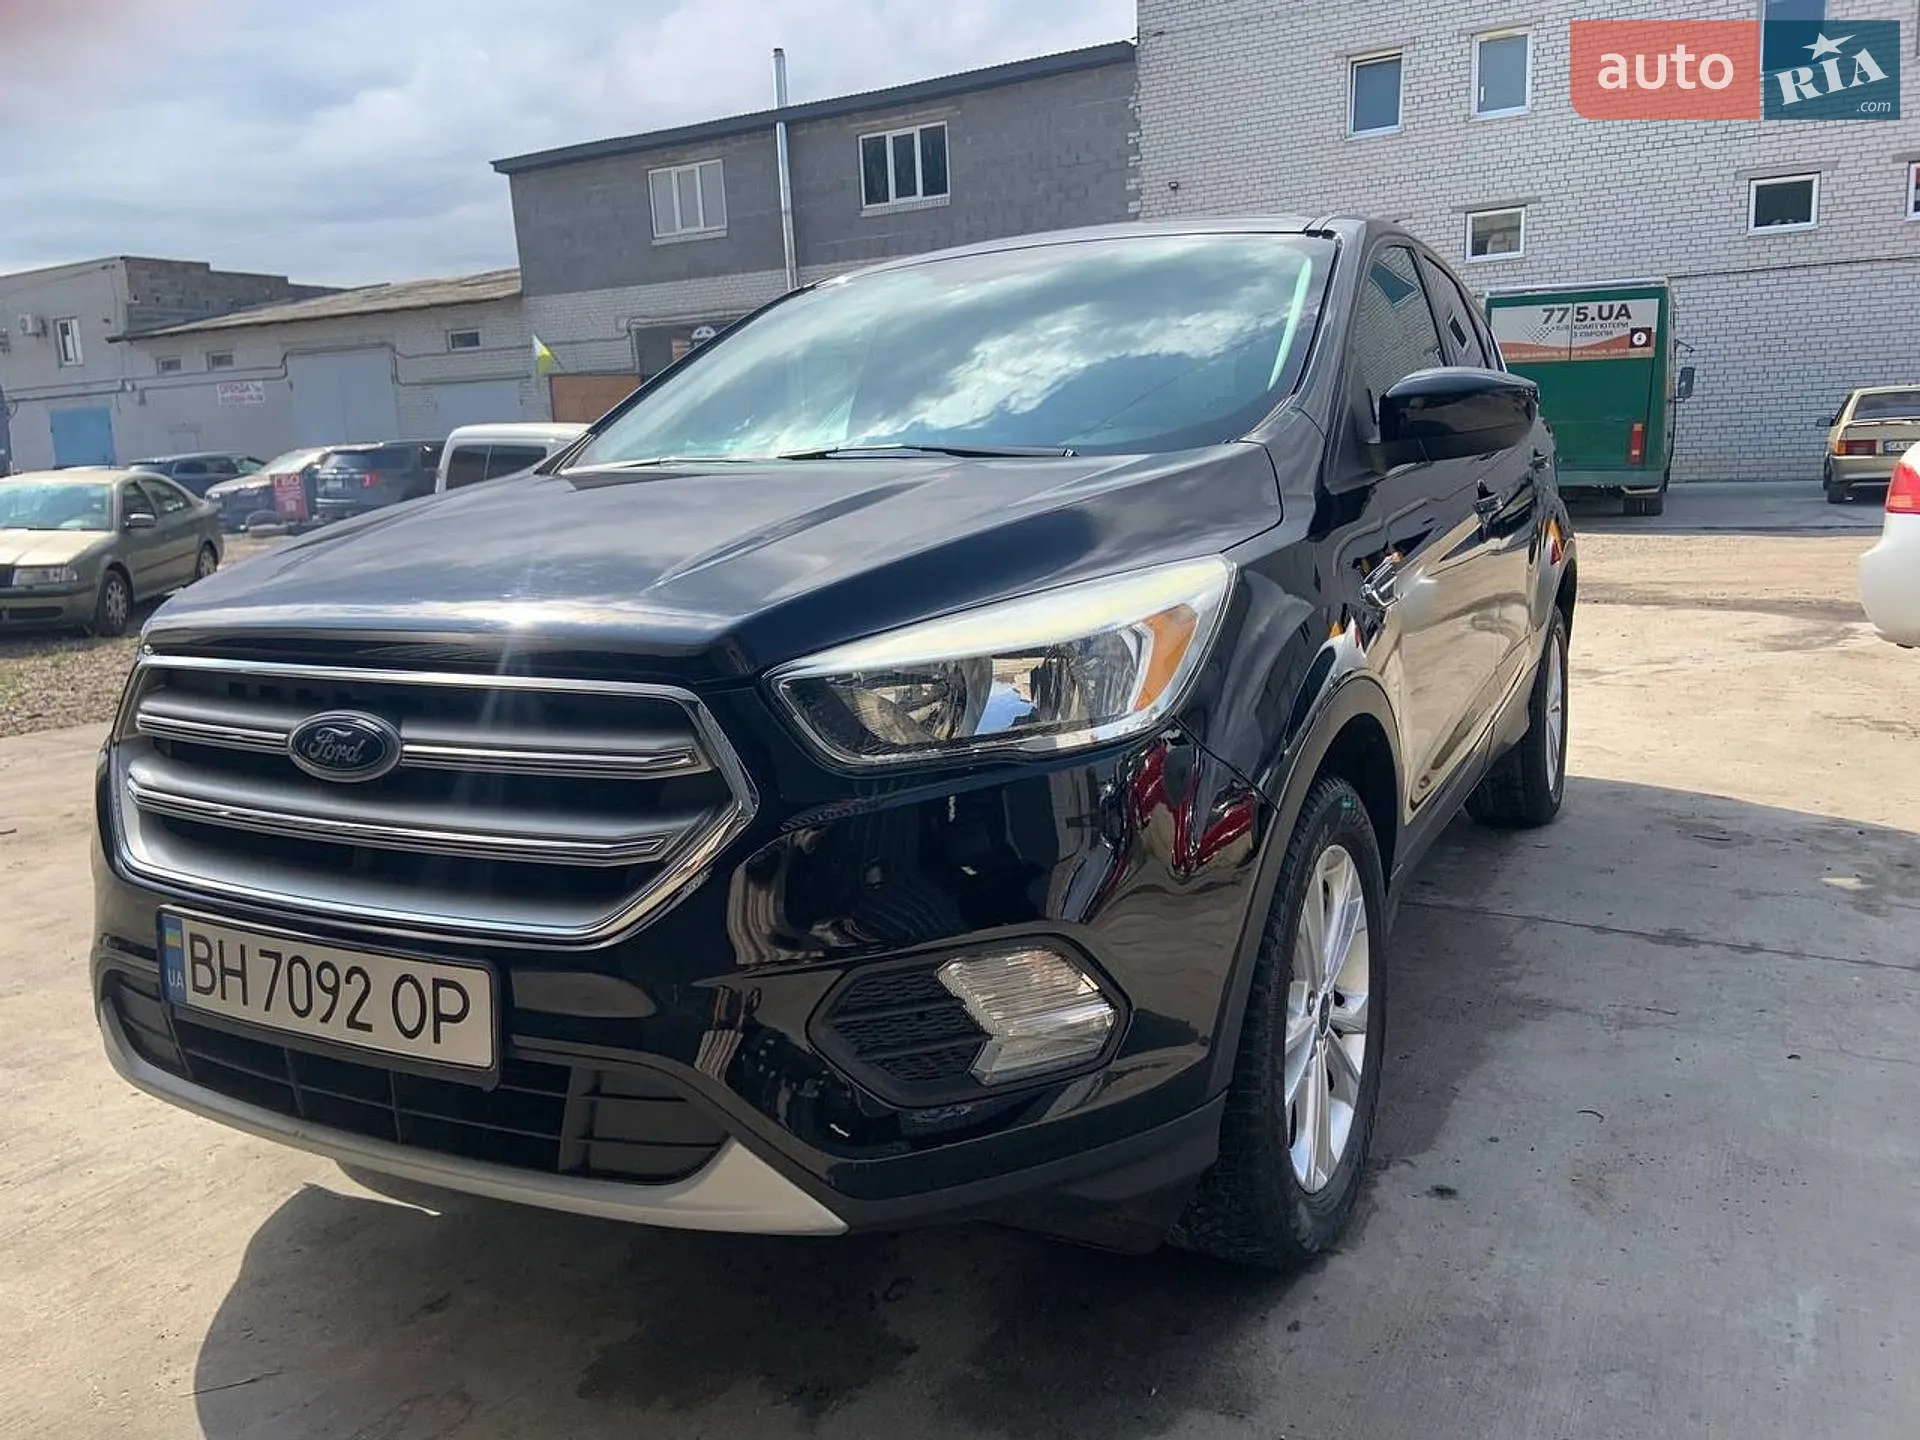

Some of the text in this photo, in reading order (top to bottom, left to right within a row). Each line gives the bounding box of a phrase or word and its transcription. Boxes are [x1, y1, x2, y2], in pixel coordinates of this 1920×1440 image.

[308, 727, 366, 762] Ford
[167, 967, 184, 989] UA
[189, 932, 471, 1044] BH 7092 OP
